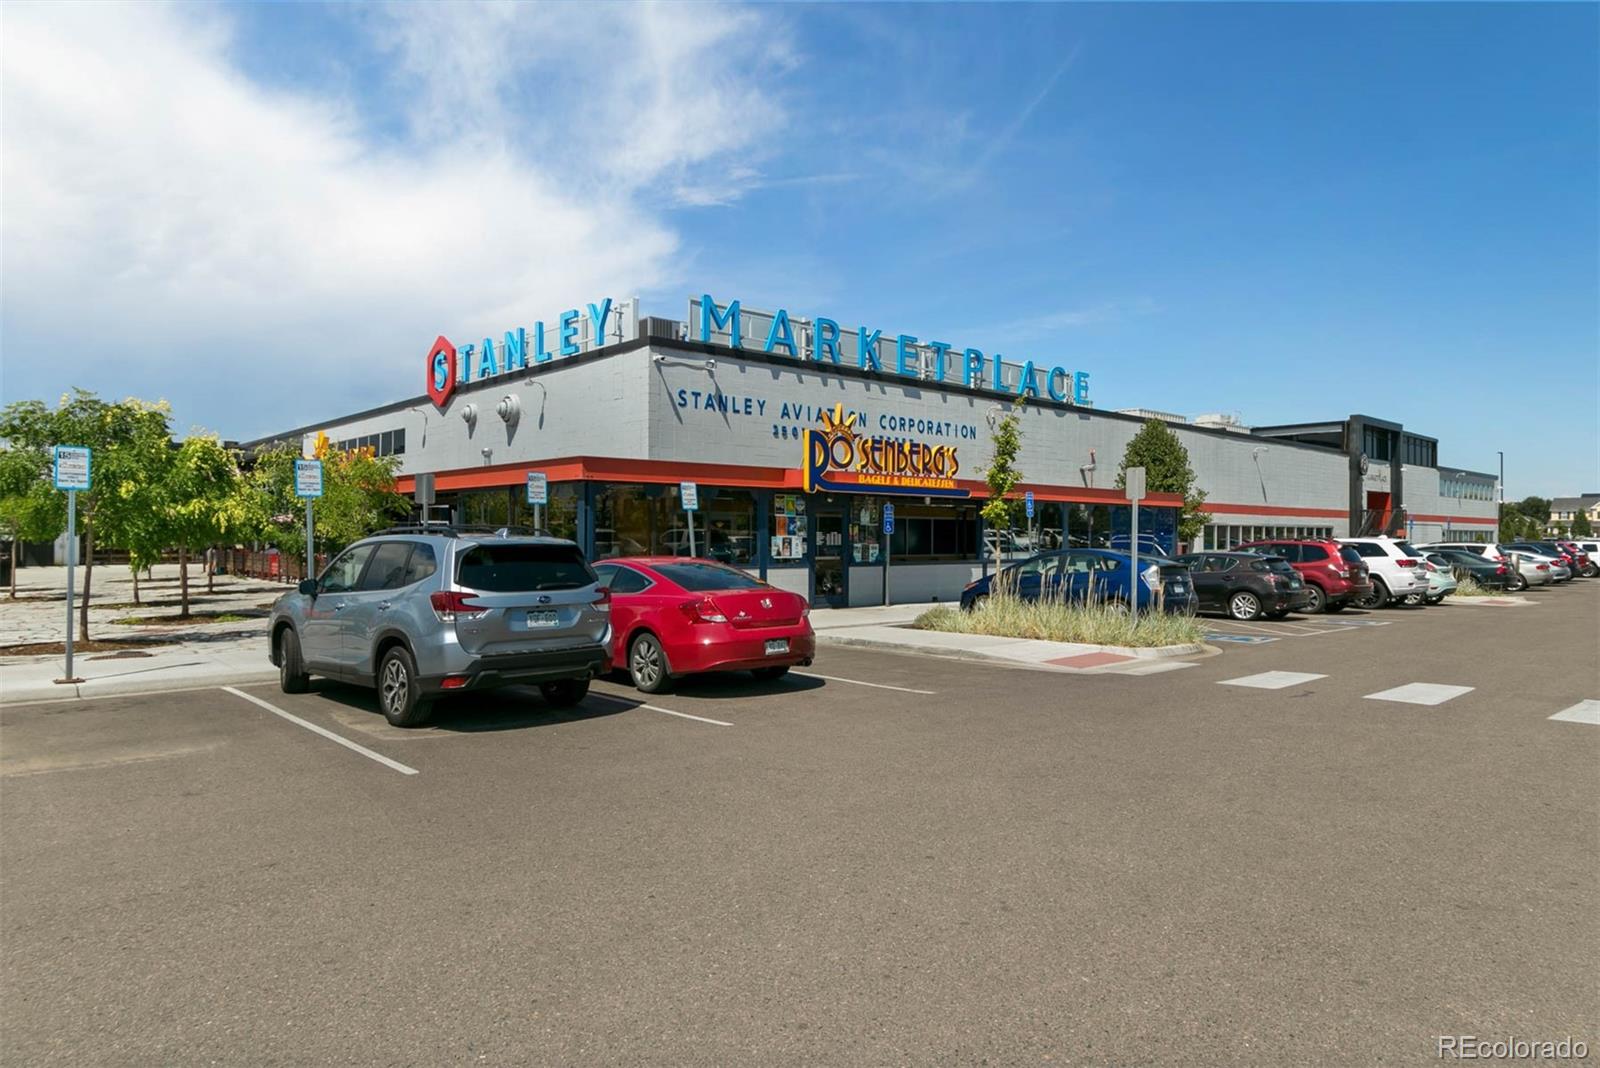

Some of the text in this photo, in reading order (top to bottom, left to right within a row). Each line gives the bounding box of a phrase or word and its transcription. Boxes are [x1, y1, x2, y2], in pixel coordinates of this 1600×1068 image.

[433, 297, 613, 392] STANLEY
[700, 294, 1091, 405] MARKETPLACE
[678, 389, 766, 416] STANLEY
[879, 414, 977, 440] CORPORATION
[803, 428, 960, 493] ROSENBERG'S
[858, 474, 890, 486] BAGELS
[901, 477, 955, 489] DELICATESSEN
